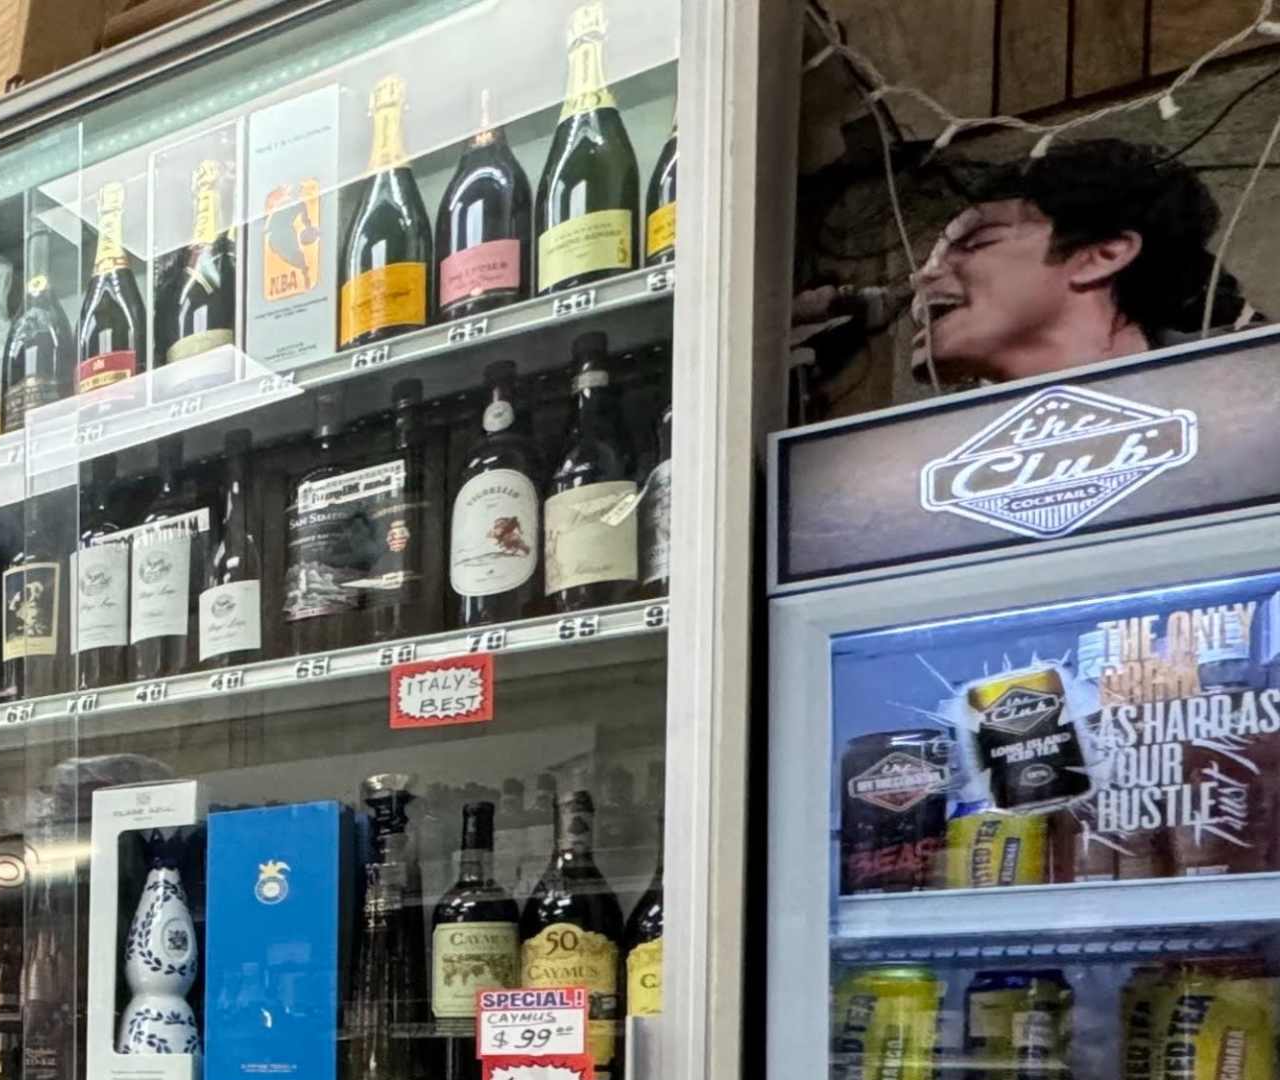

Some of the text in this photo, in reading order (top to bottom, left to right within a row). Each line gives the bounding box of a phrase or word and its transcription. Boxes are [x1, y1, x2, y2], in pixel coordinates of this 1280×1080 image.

[269, 275, 298, 297] NBA
[952, 433, 1173, 497] Club
[1011, 486, 1098, 510] COCKTAILS
[1097, 602, 1256, 668] THE ONLY
[420, 696, 478, 713] BEST
[1099, 689, 1280, 748] AS HARD AS
[1100, 743, 1183, 790] YOUR
[1098, 781, 1218, 833] HUSTLE
[546, 930, 578, 955] 50
[528, 965, 600, 980] CAYMUS
[487, 1012, 556, 1024] CAYMUS
